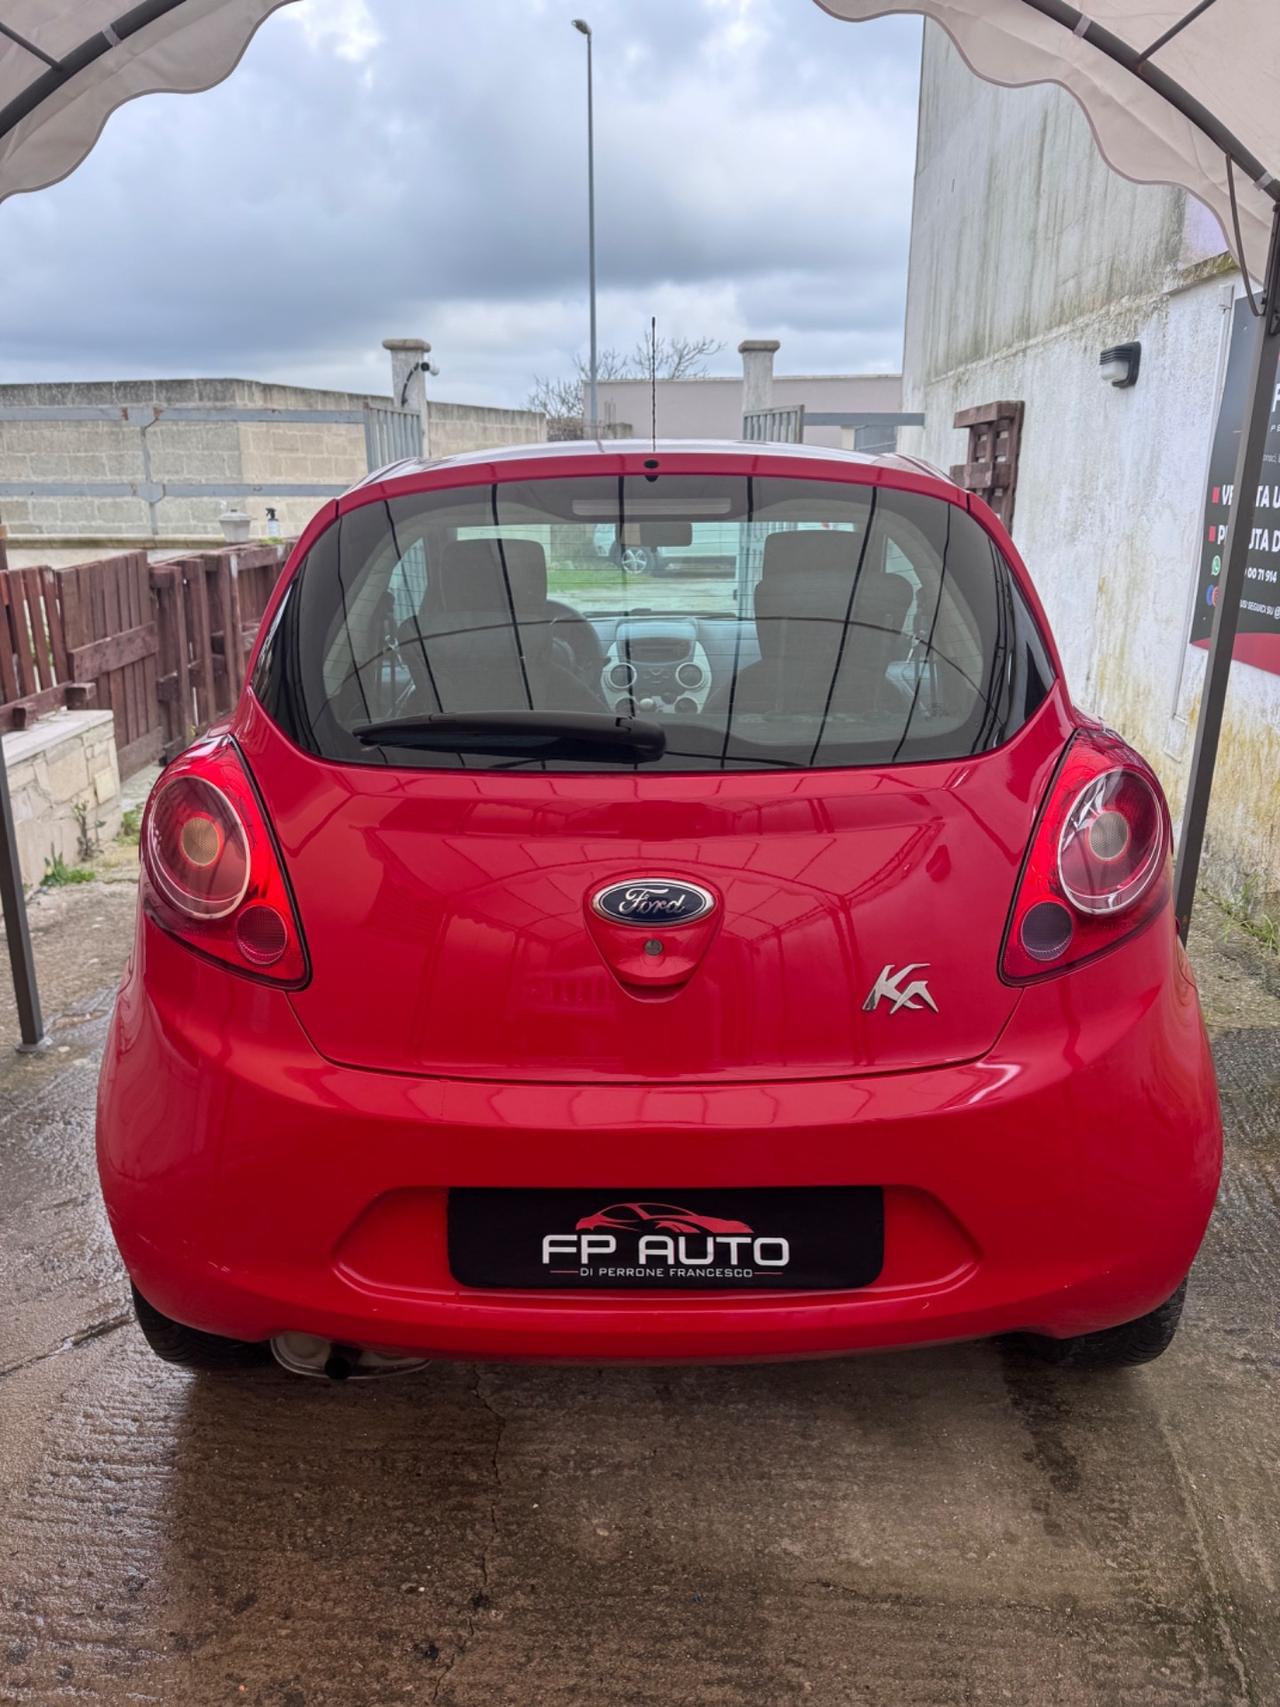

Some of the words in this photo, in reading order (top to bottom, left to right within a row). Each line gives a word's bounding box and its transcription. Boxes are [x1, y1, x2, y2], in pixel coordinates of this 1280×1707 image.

[618, 887, 686, 914] Ford
[542, 1234, 617, 1265] FP
[638, 1235, 790, 1267] AUTO
[580, 1267, 593, 1277] DI
[599, 1267, 664, 1277] PERRONE
[669, 1268, 753, 1278] FRANCESCO
